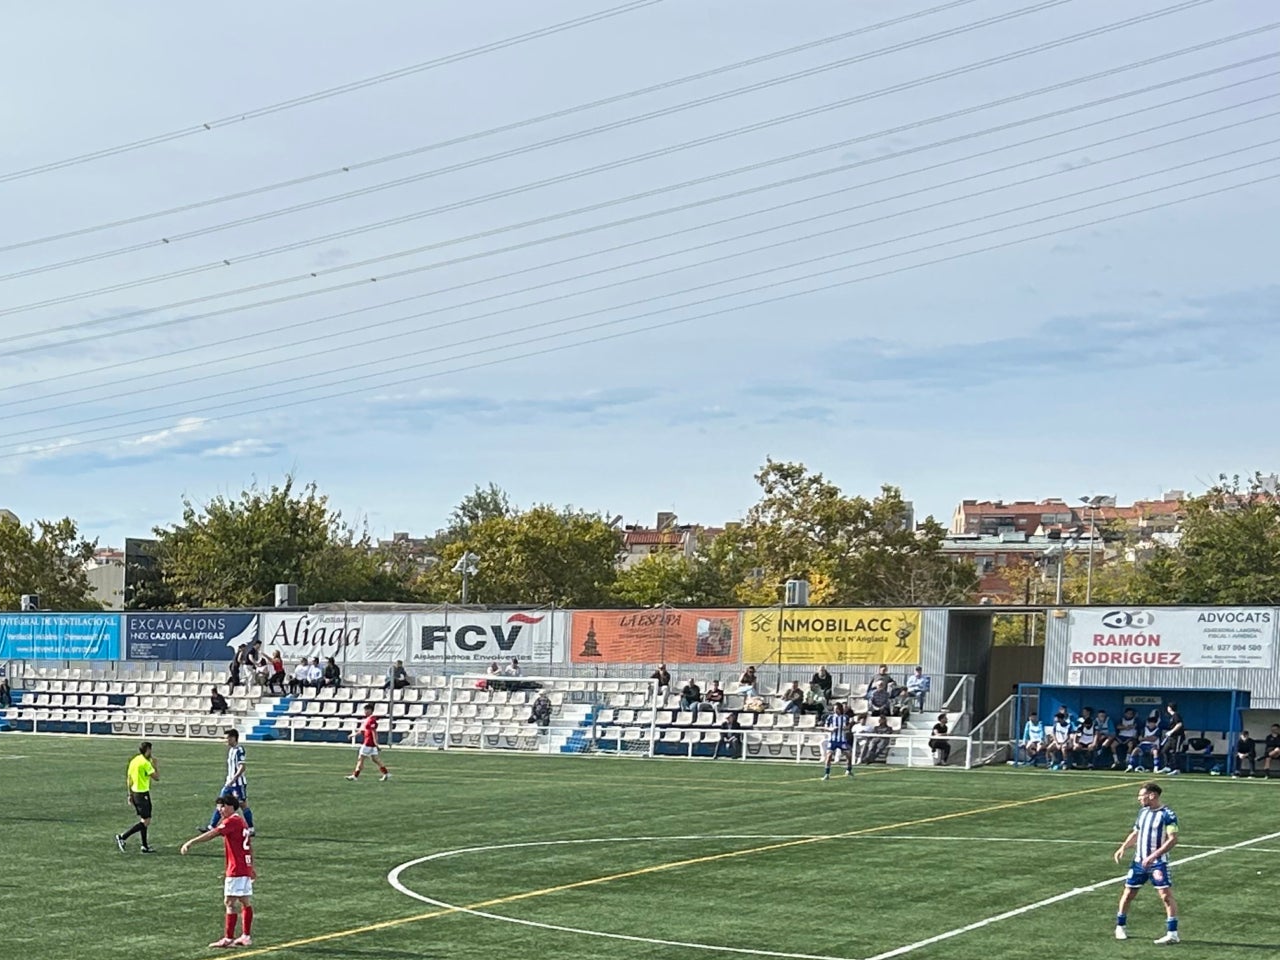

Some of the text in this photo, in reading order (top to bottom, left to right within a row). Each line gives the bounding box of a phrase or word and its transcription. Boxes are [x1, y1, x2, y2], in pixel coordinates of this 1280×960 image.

[130, 619, 226, 630] EXCAVACIONS
[1197, 612, 1271, 623] ADVOCATS
[778, 619, 892, 632] INMOBILACC
[150, 632, 187, 640] CAZORLA
[188, 632, 224, 640] ARTIGAS
[269, 614, 361, 657] Aliaga
[422, 625, 523, 651] FCV
[1093, 631, 1161, 646] RAMÓN
[1071, 649, 1181, 665] RODRÍGUEZ
